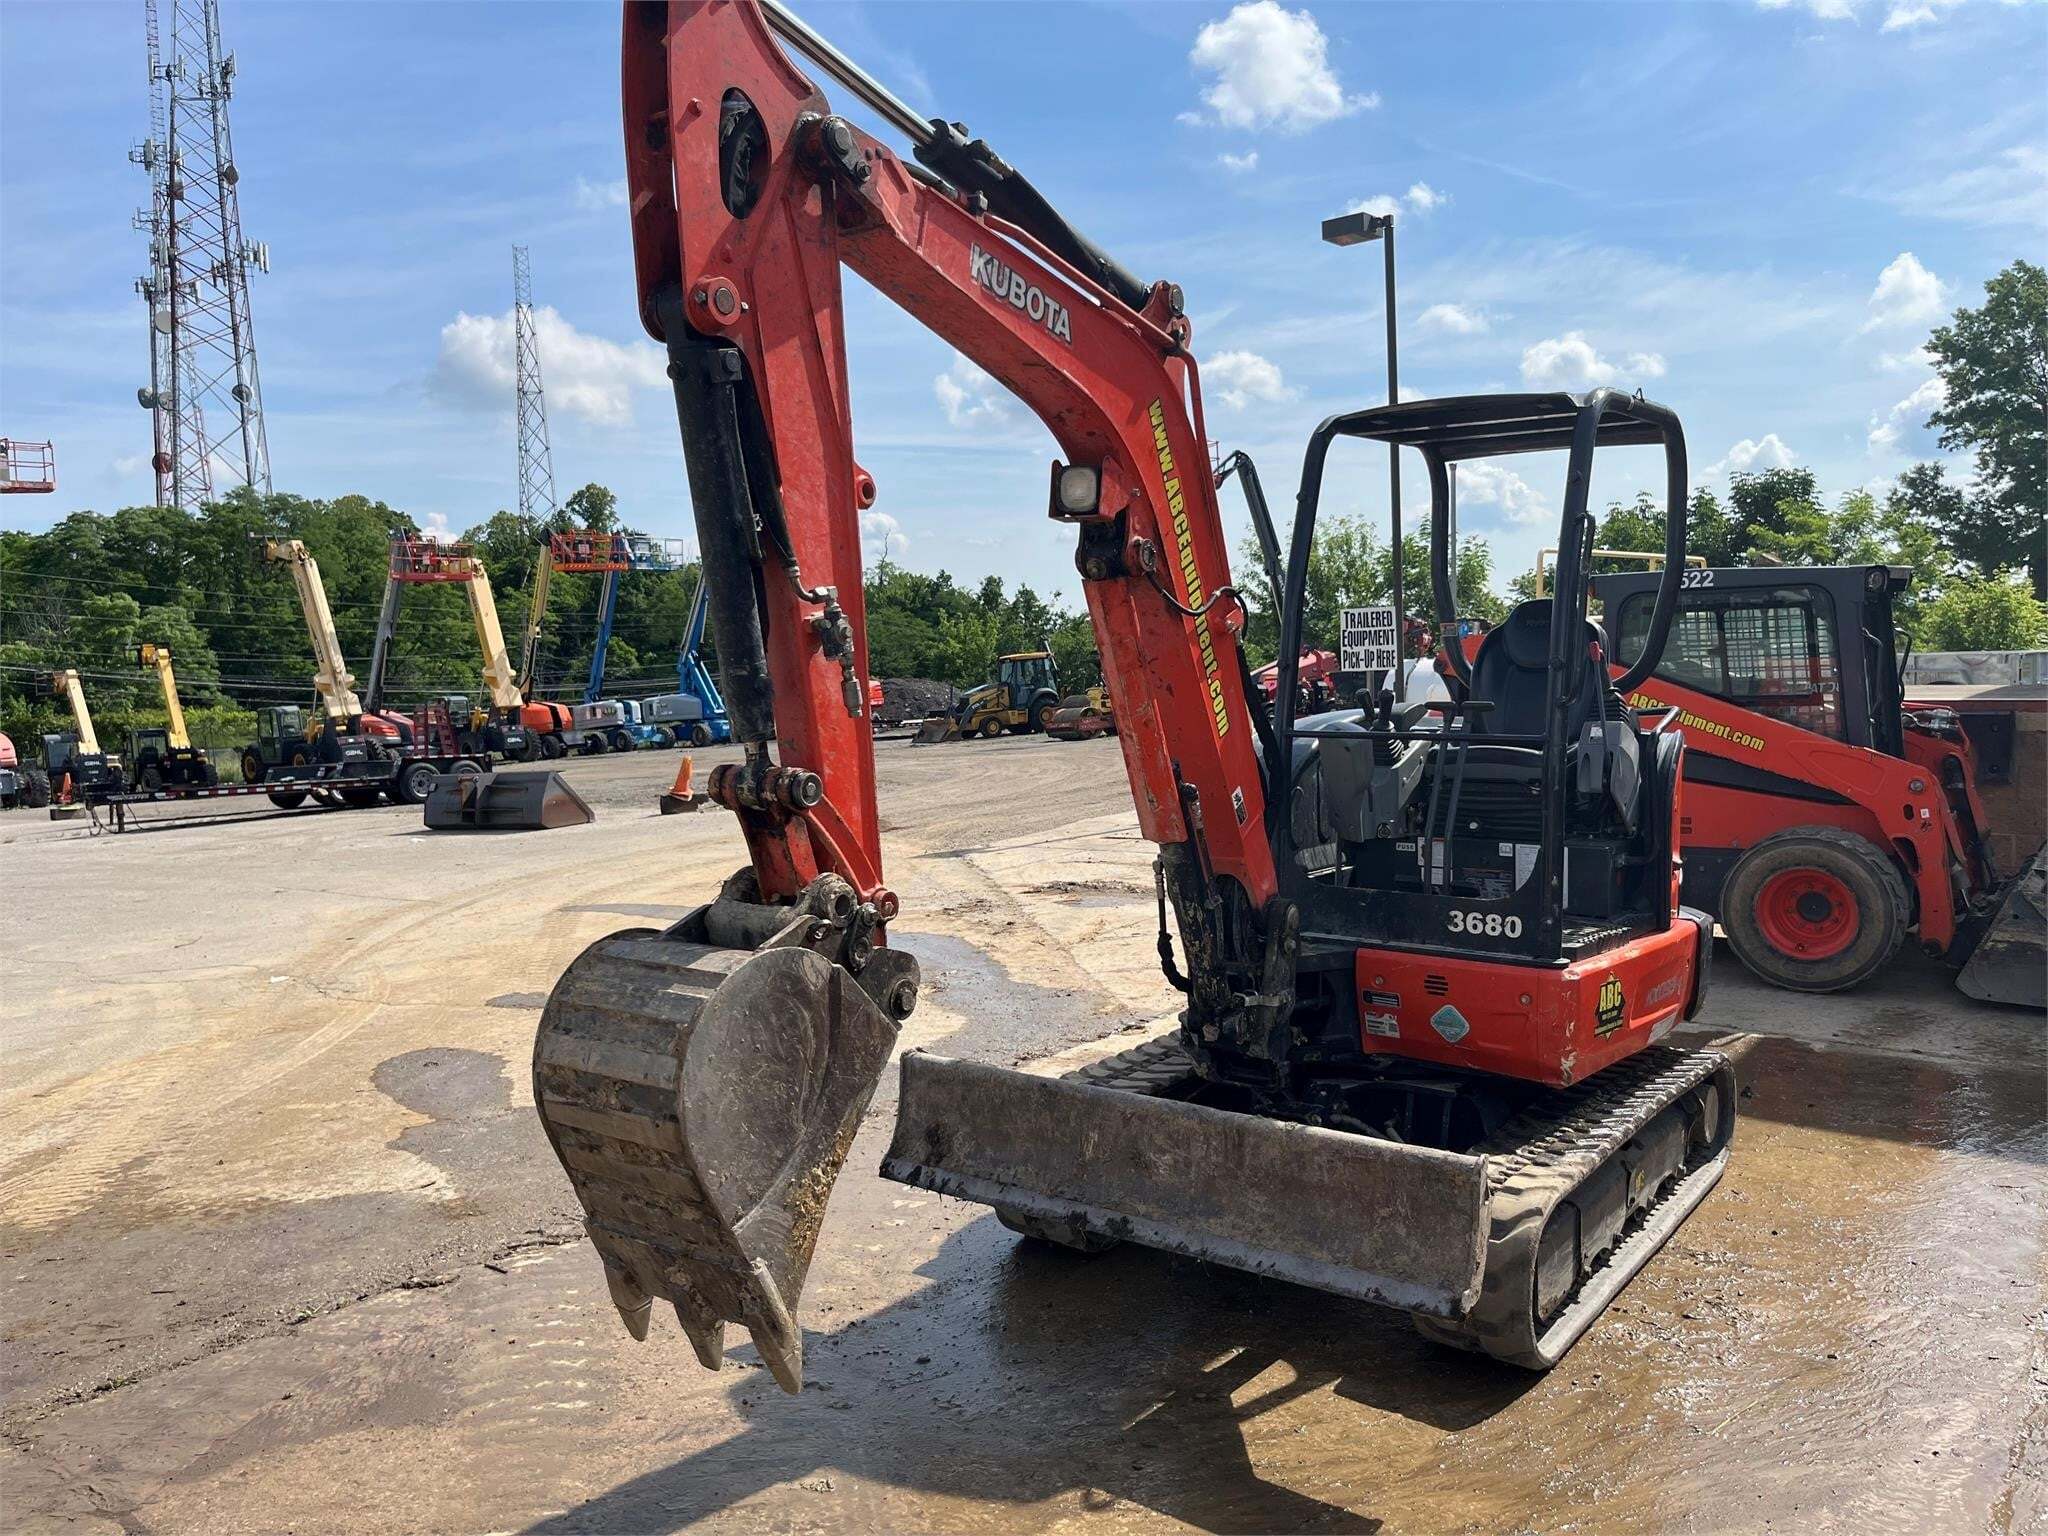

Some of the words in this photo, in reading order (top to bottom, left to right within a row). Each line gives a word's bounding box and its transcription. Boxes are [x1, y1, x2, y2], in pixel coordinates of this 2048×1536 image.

[970, 243, 1072, 344] KUBOTA
[1343, 610, 1393, 629] TRAILERED
[1341, 629, 1396, 649] EQUIPMENT
[1342, 649, 1375, 669] PICK-UP
[1376, 648, 1396, 668] HERE
[1447, 910, 1522, 939] 3680
[1599, 981, 1622, 1012] ABC
